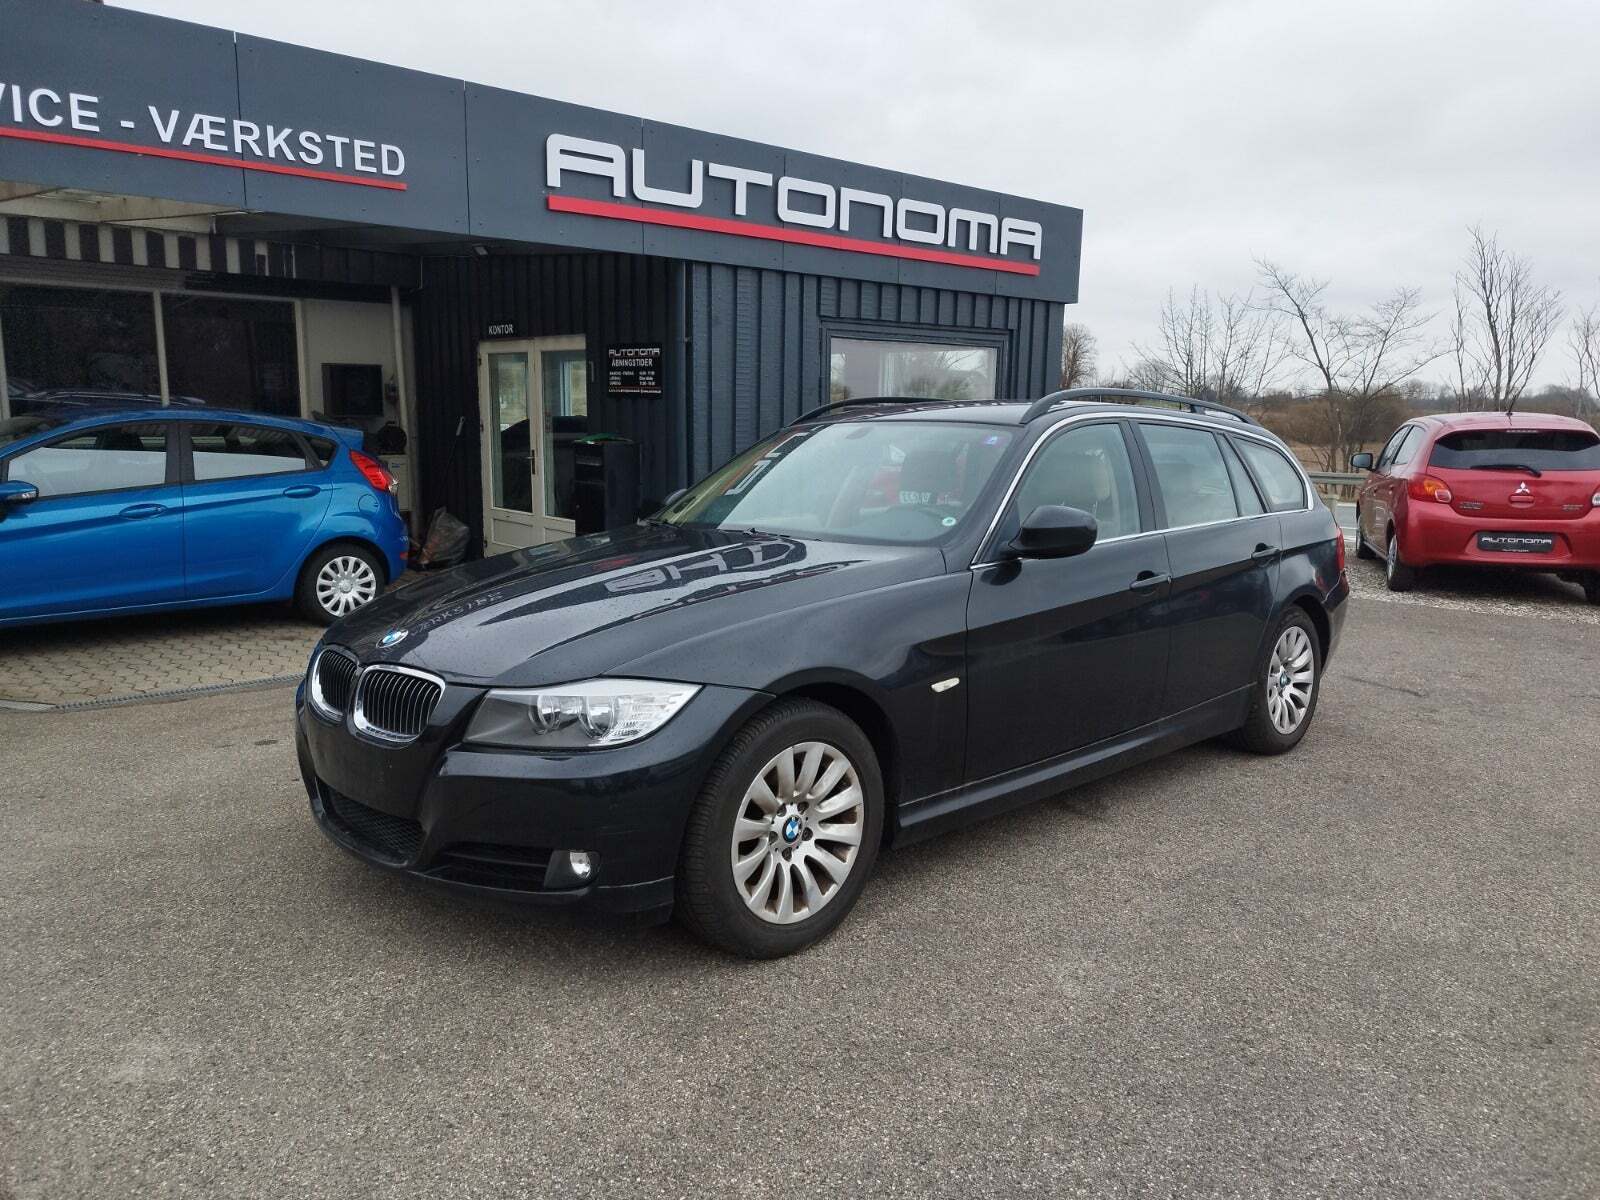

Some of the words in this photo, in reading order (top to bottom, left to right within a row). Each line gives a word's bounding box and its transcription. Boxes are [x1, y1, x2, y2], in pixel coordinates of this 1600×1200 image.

[0, 83, 99, 132] ICE
[148, 105, 406, 177] VÆRKSTED
[546, 133, 1042, 261] AUTONOMA
[488, 324, 514, 336] KONTOR
[608, 348, 661, 357] AUTONOMA
[1482, 537, 1553, 545] AUTONOMA
